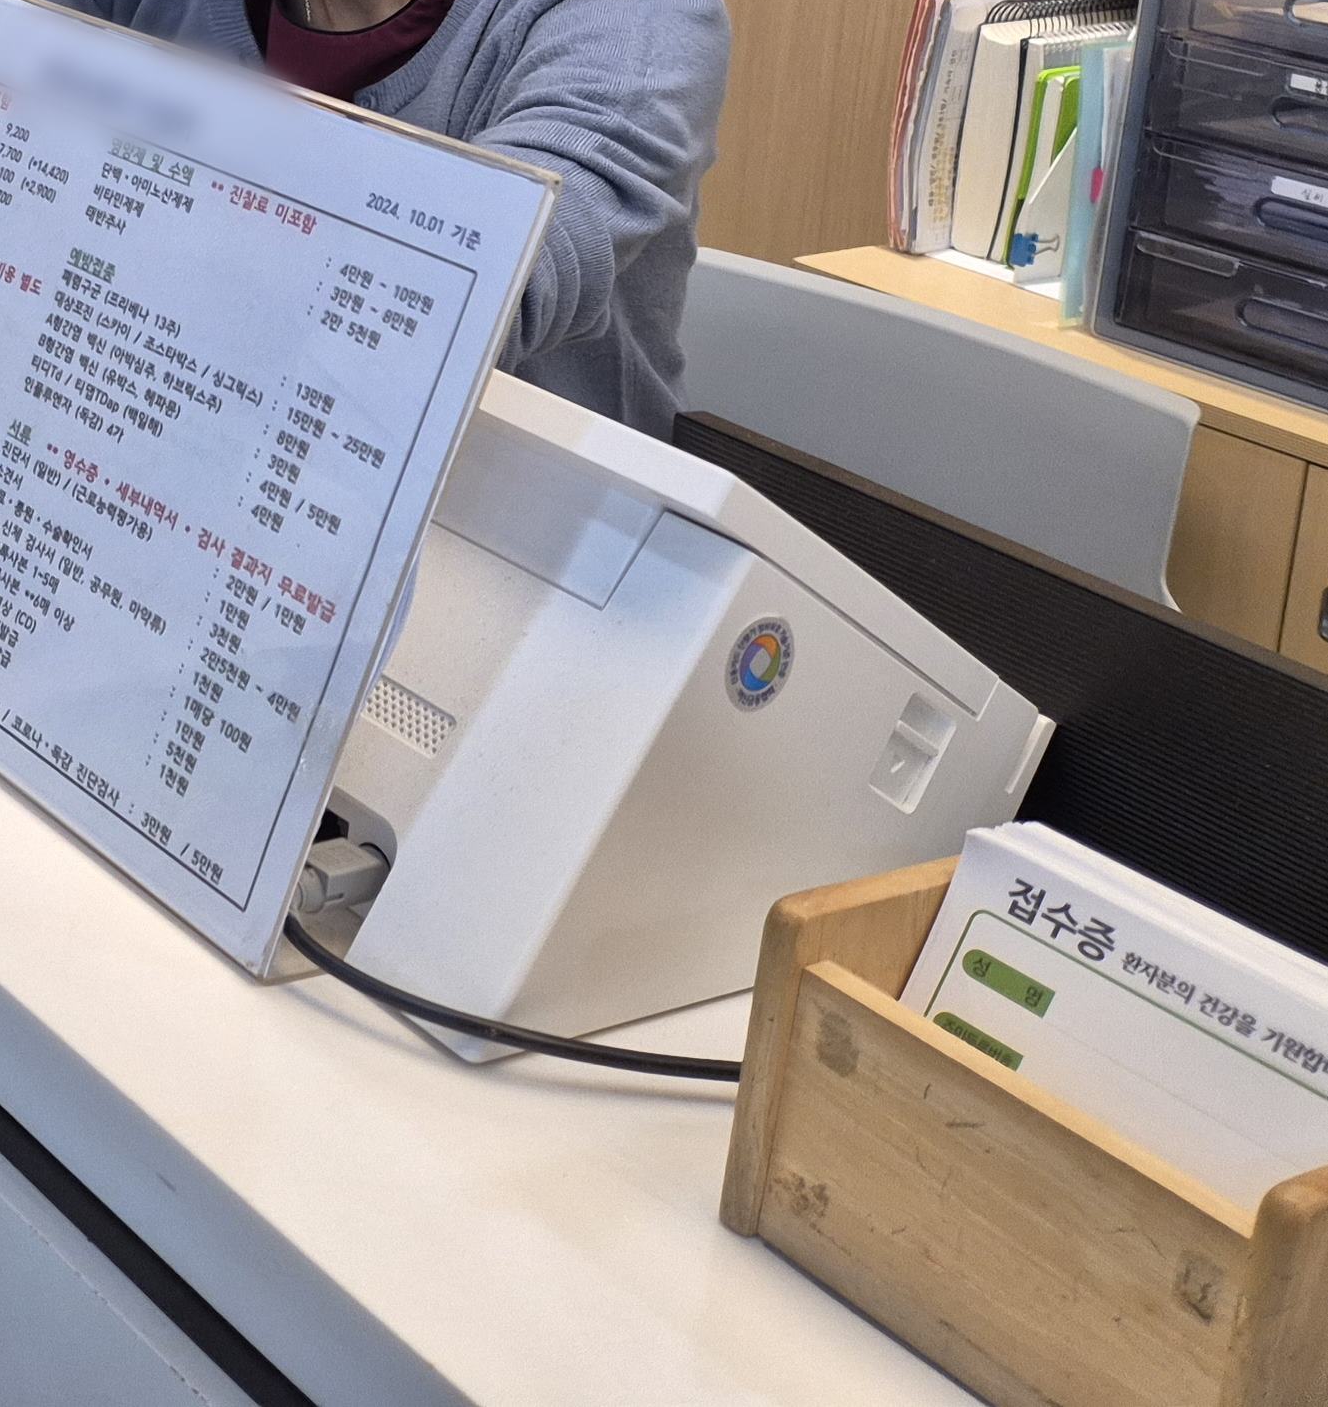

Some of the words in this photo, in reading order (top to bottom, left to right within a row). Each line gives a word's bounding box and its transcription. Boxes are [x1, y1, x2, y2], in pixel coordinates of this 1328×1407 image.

[147, 152, 165, 175] 및
[164, 158, 196, 188] 수액
[226, 183, 271, 218] 진찰료
[271, 201, 319, 237] 미포함
[363, 190, 405, 221] 2024.
[406, 206, 446, 236] 10.01
[447, 222, 485, 253] 기준
[66, 244, 118, 286] 예방접종
[90, 181, 146, 219] 비타민제제
[327, 283, 366, 316] 3만원
[379, 306, 419, 339] 8만원
[336, 260, 375, 291] 4만원
[389, 282, 436, 317] 10만원
[43, 309, 84, 344] A형간염
[83, 330, 108, 357] 백신
[159, 369, 224, 417] 하브릭스주)
[273, 427, 311, 462] 8만원
[51, 288, 95, 324] 대상포진
[93, 309, 133, 342] (스카이
[140, 333, 200, 376] 조스타박스
[208, 367, 265, 410] 싱그릭스)
[283, 404, 328, 441] 15만원
[340, 432, 387, 471] 25만원
[101, 287, 151, 326] (프리베나
[151, 312, 183, 341] 13주)
[292, 380, 336, 417] 13만원
[317, 307, 346, 335] 2만
[343, 319, 382, 352] 5천원
[20, 373, 74, 417] 인플루엔자
[72, 402, 105, 434] (독감)
[103, 420, 126, 445] 4가
[247, 499, 285, 535] 4만원
[28, 352, 64, 385] 티디Td
[120, 402, 165, 441] (백일해)
[256, 475, 294, 510] 4만원
[303, 501, 343, 537] 5만원
[35, 331, 76, 366] B형간염
[75, 352, 100, 378] 백신
[99, 364, 142, 401] (유박스,
[265, 451, 302, 486] 3만원
[0, 438, 32, 471] 진단서
[31, 457, 63, 489] (일반)
[69, 480, 155, 545] (근로능력평가용)
[223, 572, 260, 608] 2만원
[270, 600, 308, 637] 1만원
[6, 416, 34, 448] 서류
[59, 447, 101, 487] 영수증
[112, 478, 180, 532] 세부내역서
[194, 525, 228, 561] 검사
[226, 545, 274, 588] 결과지
[273, 572, 339, 626] 무료발급
[0, 516, 24, 545] 신체
[22, 531, 57, 567] 검사서
[125, 597, 168, 639] 마약류)
[197, 644, 252, 693] 2만5천원
[263, 686, 302, 726] 4만원
[50, 604, 76, 635] 이상
[180, 692, 217, 731] 1매당
[215, 715, 253, 755] 100원
[206, 620, 243, 657] 3천원
[215, 596, 251, 633] 1만원
[12, 606, 38, 637] (CD)
[171, 716, 207, 754] 1만원
[189, 668, 225, 706] 1천원
[156, 760, 190, 799] 1천원
[163, 737, 199, 776] 5천원
[73, 761, 121, 809] 진단검사
[137, 809, 173, 851] 3만원
[187, 846, 224, 890] 5만원
[971, 955, 990, 980] 성
[1023, 984, 1044, 1007] 명
[1007, 877, 1118, 963] 접수증
[1120, 950, 1197, 1005] 환자분의
[1198, 991, 1258, 1038] 건강을
